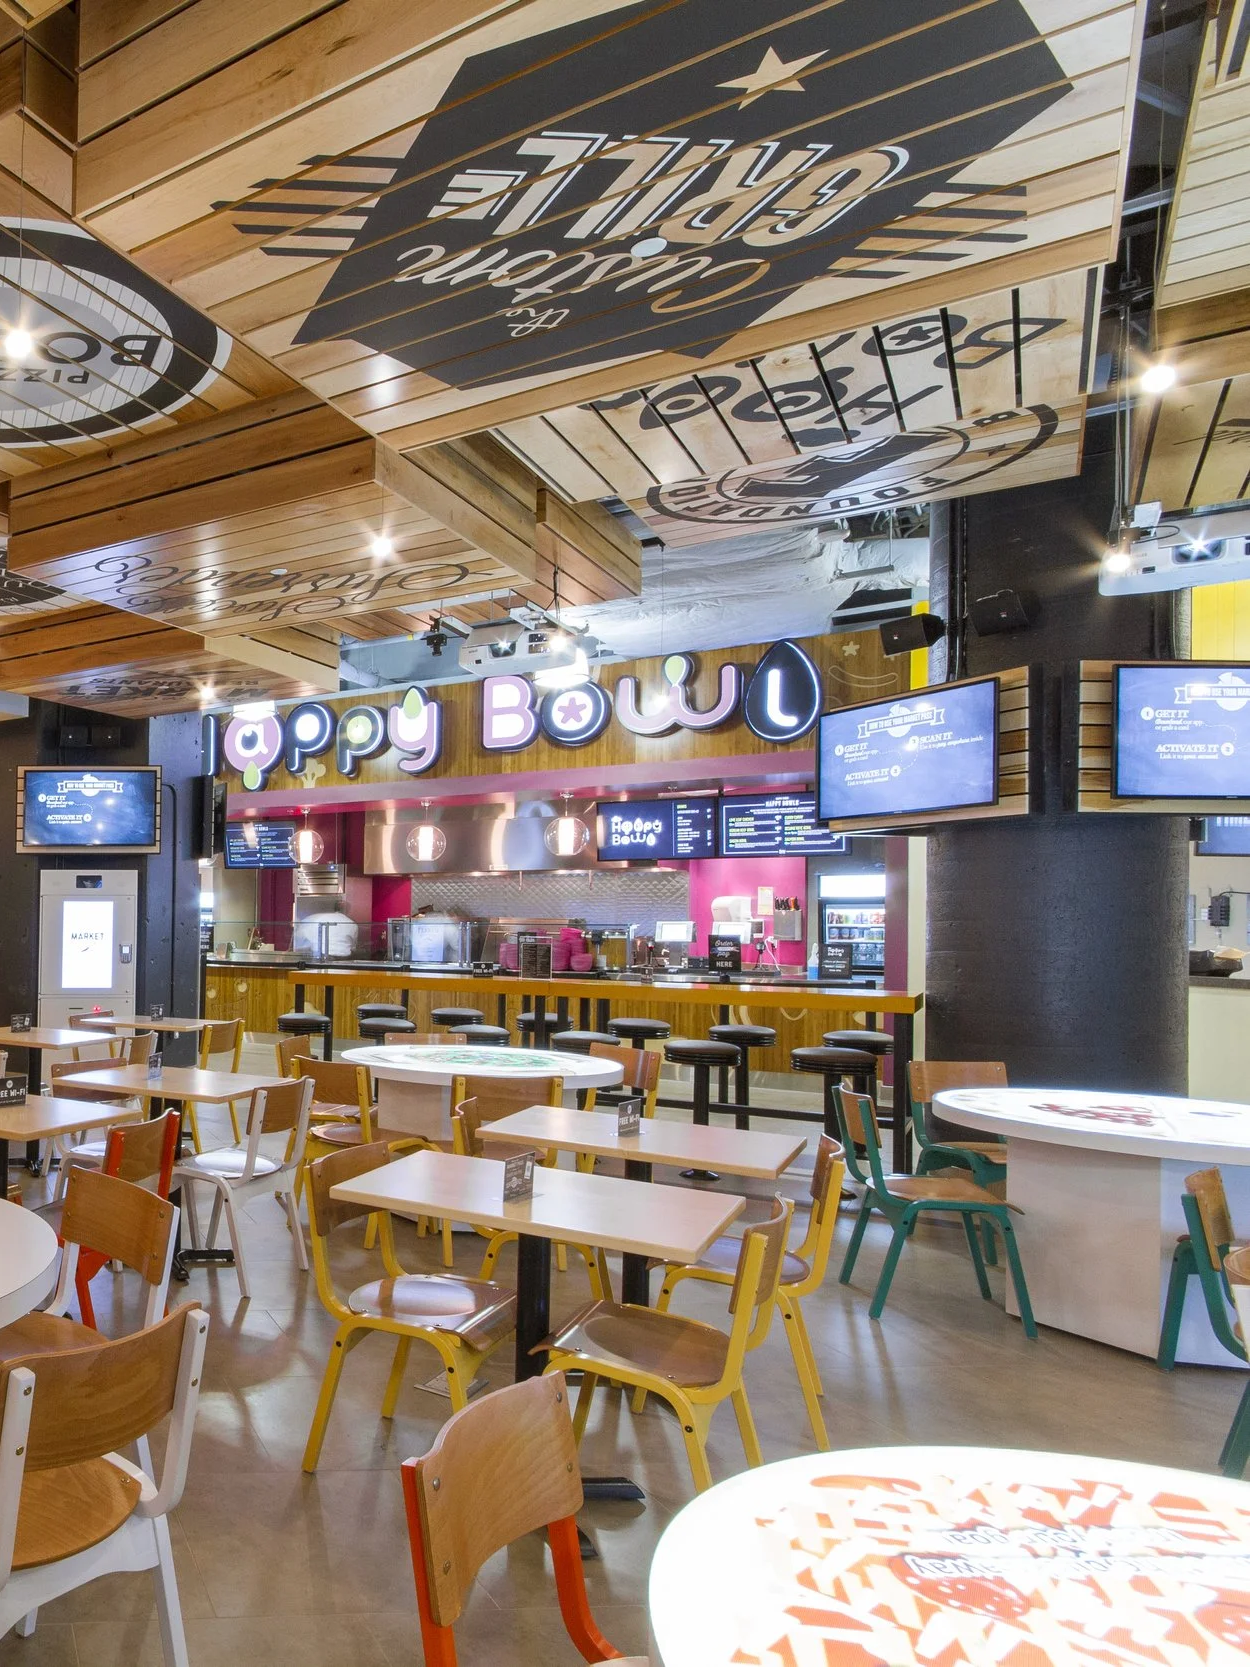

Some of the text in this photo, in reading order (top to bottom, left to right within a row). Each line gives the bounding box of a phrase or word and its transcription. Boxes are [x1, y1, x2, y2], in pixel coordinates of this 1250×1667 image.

[427, 132, 911, 248] GRILLE
[396, 245, 771, 314] Custom
[497, 306, 571, 338] the
[58, 684, 270, 698] MRKET
[481, 641, 824, 751] Bowl
[1154, 709, 1178, 718] GET
[1177, 709, 1190, 718] IT
[844, 744, 860, 753] GET
[1155, 743, 1207, 753] ACTIVATE
[1207, 743, 1219, 753] IT
[844, 769, 879, 781] ACTIVATE
[70, 932, 105, 941] MARKET
[714, 939, 734, 947] Order
[9, 1088, 26, 1097] WI-FI
